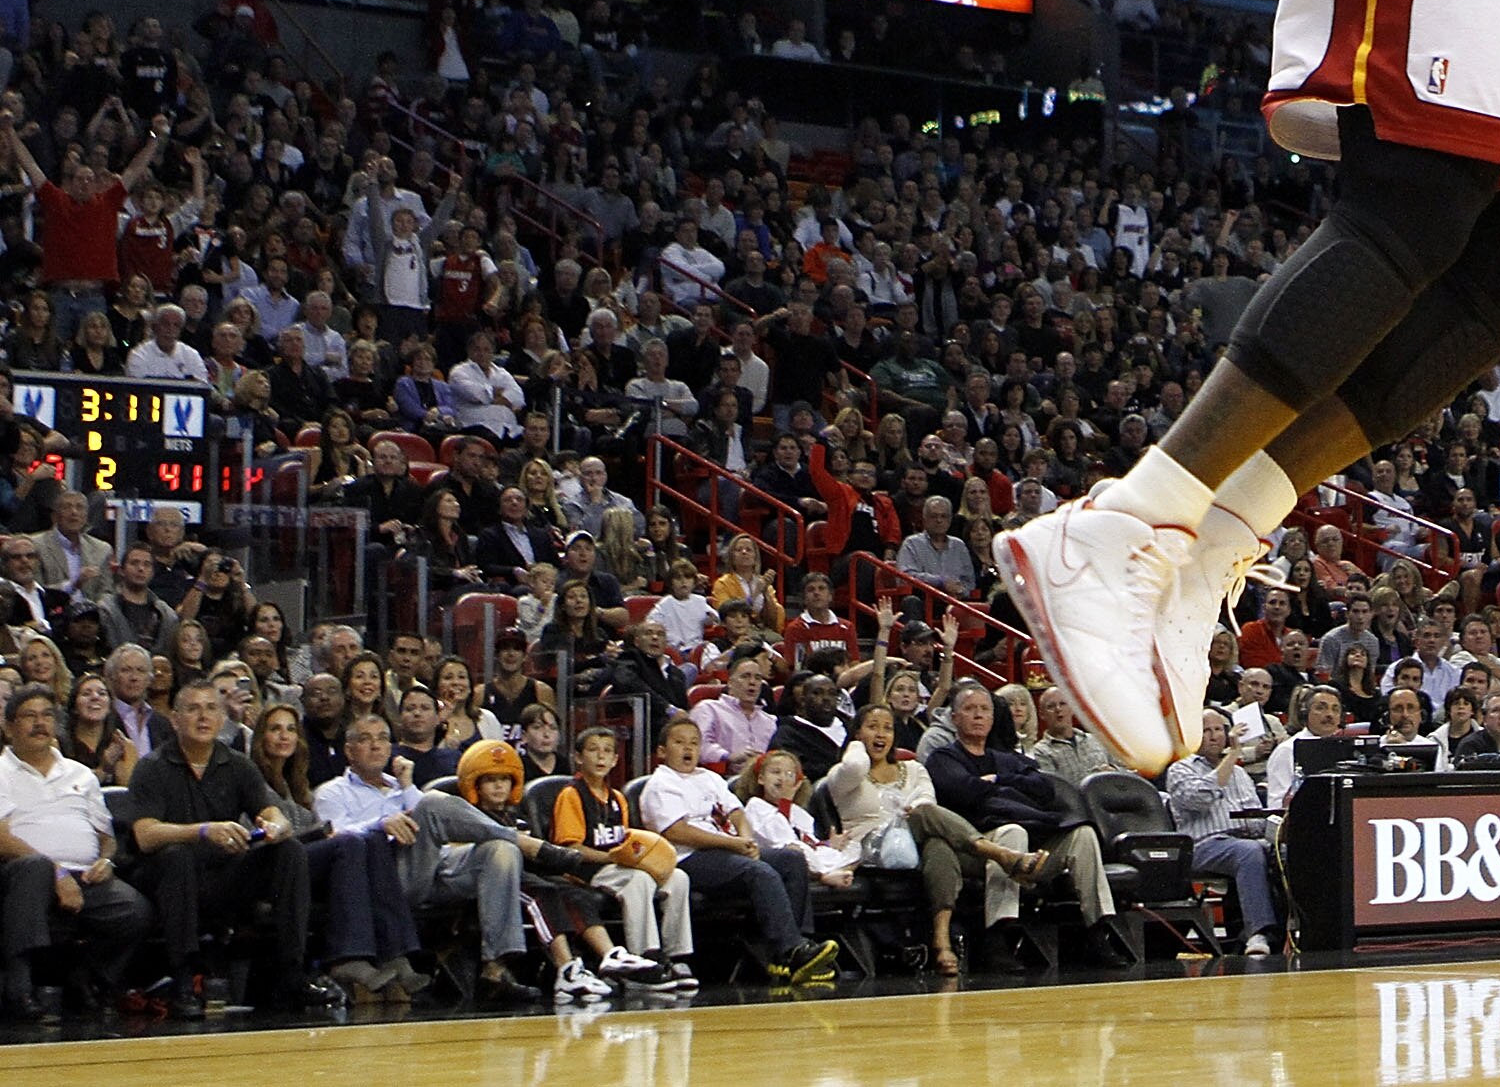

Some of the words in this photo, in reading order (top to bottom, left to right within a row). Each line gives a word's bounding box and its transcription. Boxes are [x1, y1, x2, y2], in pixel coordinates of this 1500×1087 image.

[81, 388, 161, 424] 3:11
[163, 437, 193, 452] NETS
[96, 456, 117, 490] 2
[158, 463, 203, 492] 41
